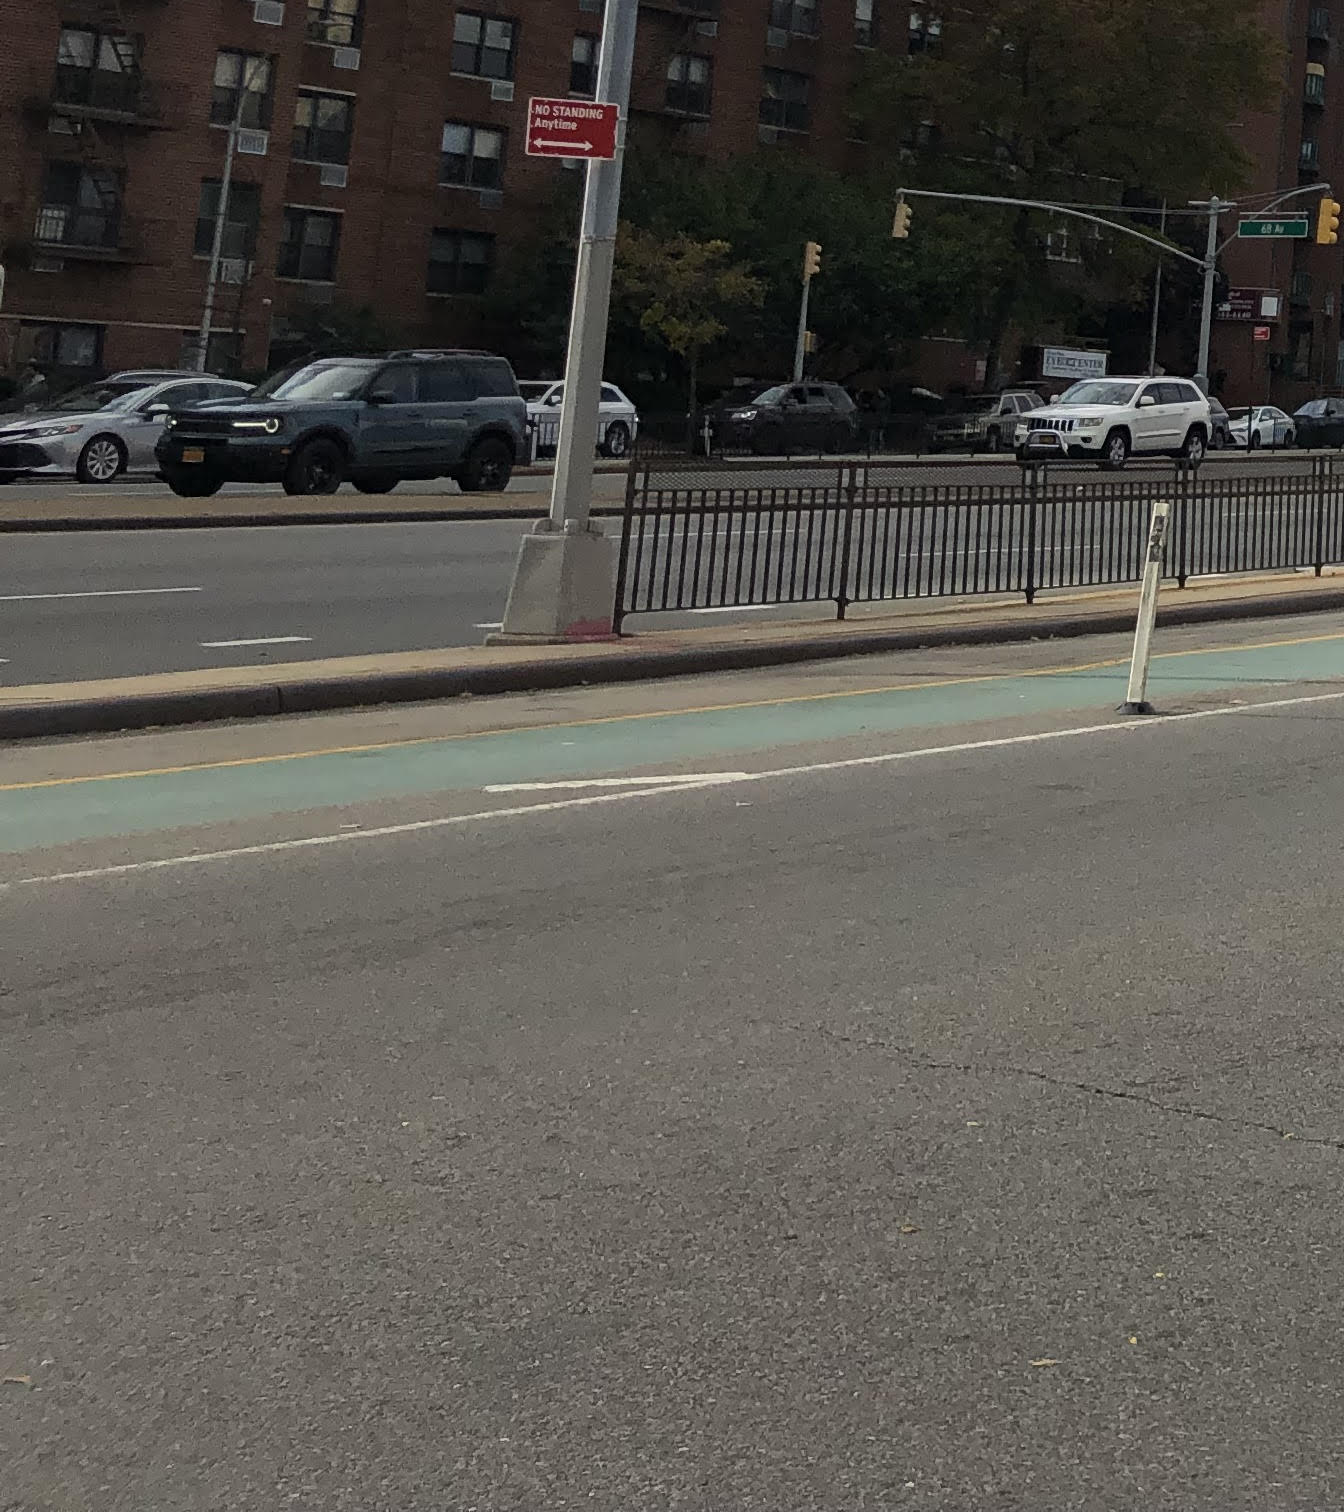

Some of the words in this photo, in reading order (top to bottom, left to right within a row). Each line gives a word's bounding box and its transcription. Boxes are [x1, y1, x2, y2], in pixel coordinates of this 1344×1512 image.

[535, 104, 551, 116] NO
[552, 105, 604, 120] STANDING
[534, 117, 578, 131] Anytime
[1261, 223, 1272, 234] 68
